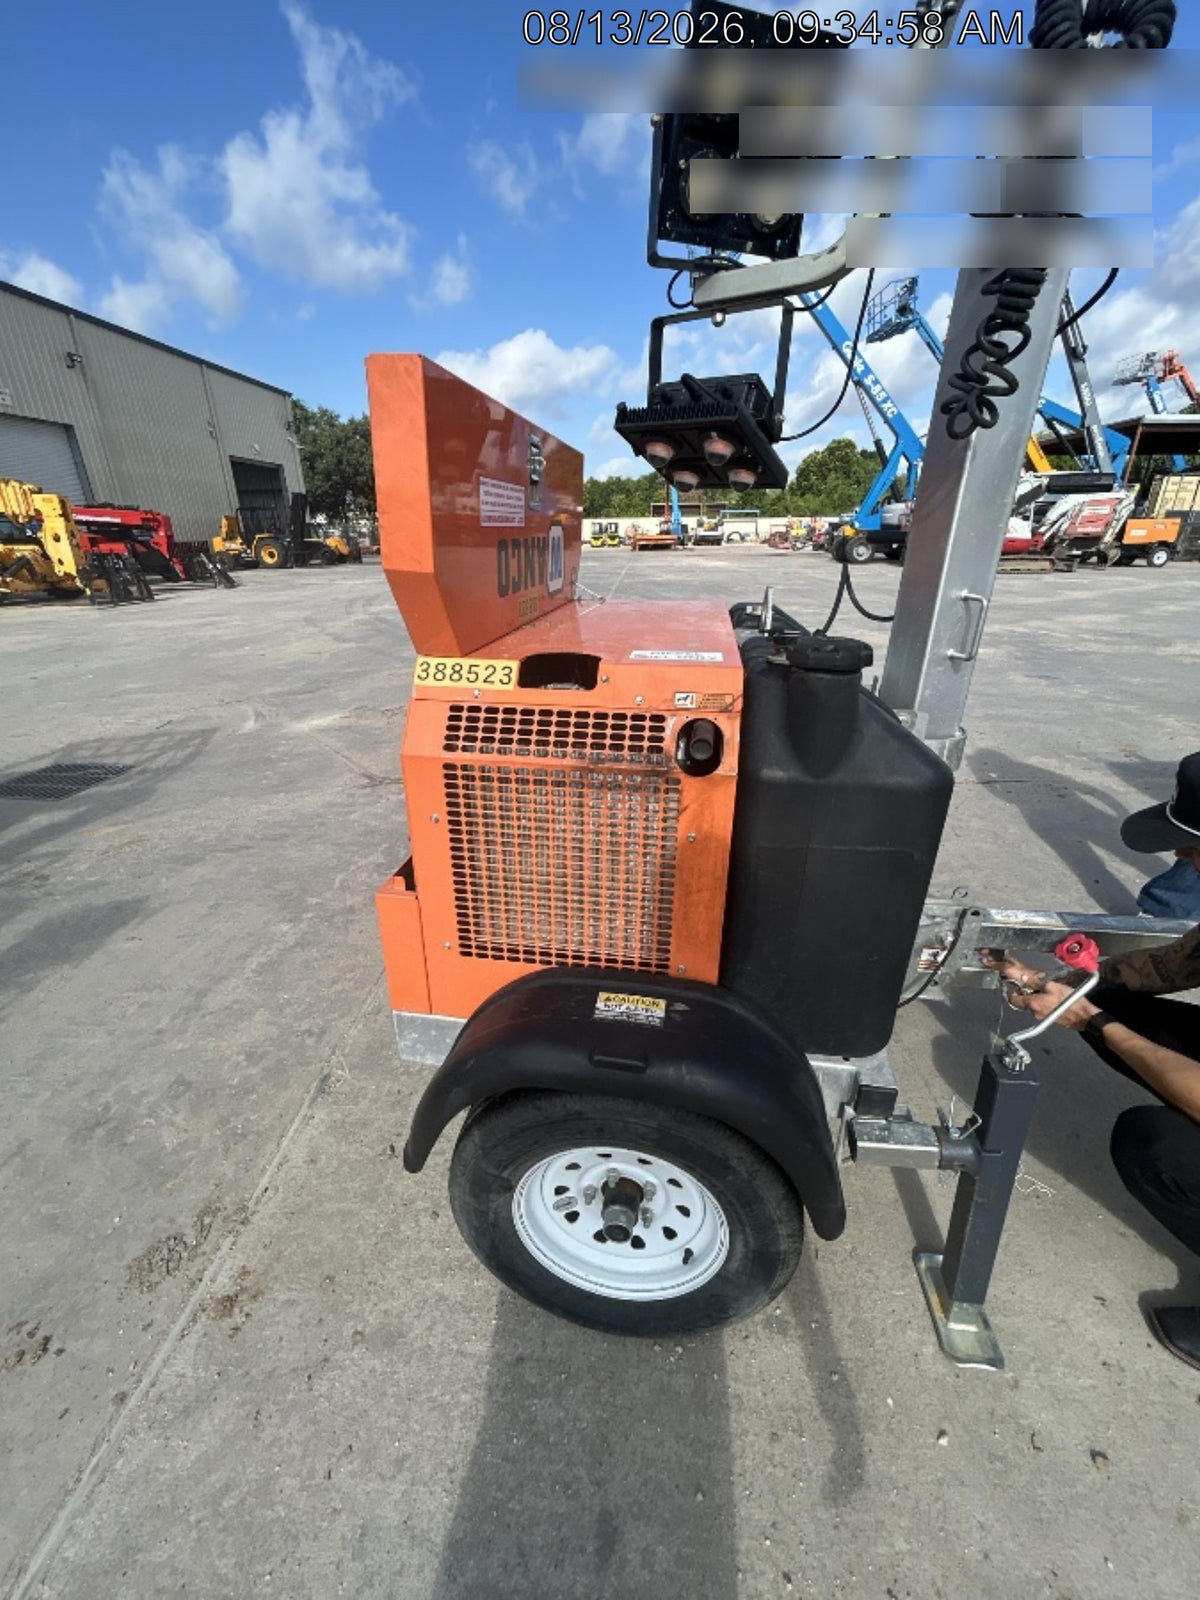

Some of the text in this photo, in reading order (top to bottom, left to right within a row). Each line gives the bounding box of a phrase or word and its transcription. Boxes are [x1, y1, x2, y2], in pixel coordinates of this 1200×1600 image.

[864, 374, 888, 402] S-85
[881, 400, 898, 418] XC
[497, 534, 563, 598] WANCO
[416, 660, 514, 686] 388523
[613, 995, 660, 1007] CAUTION
